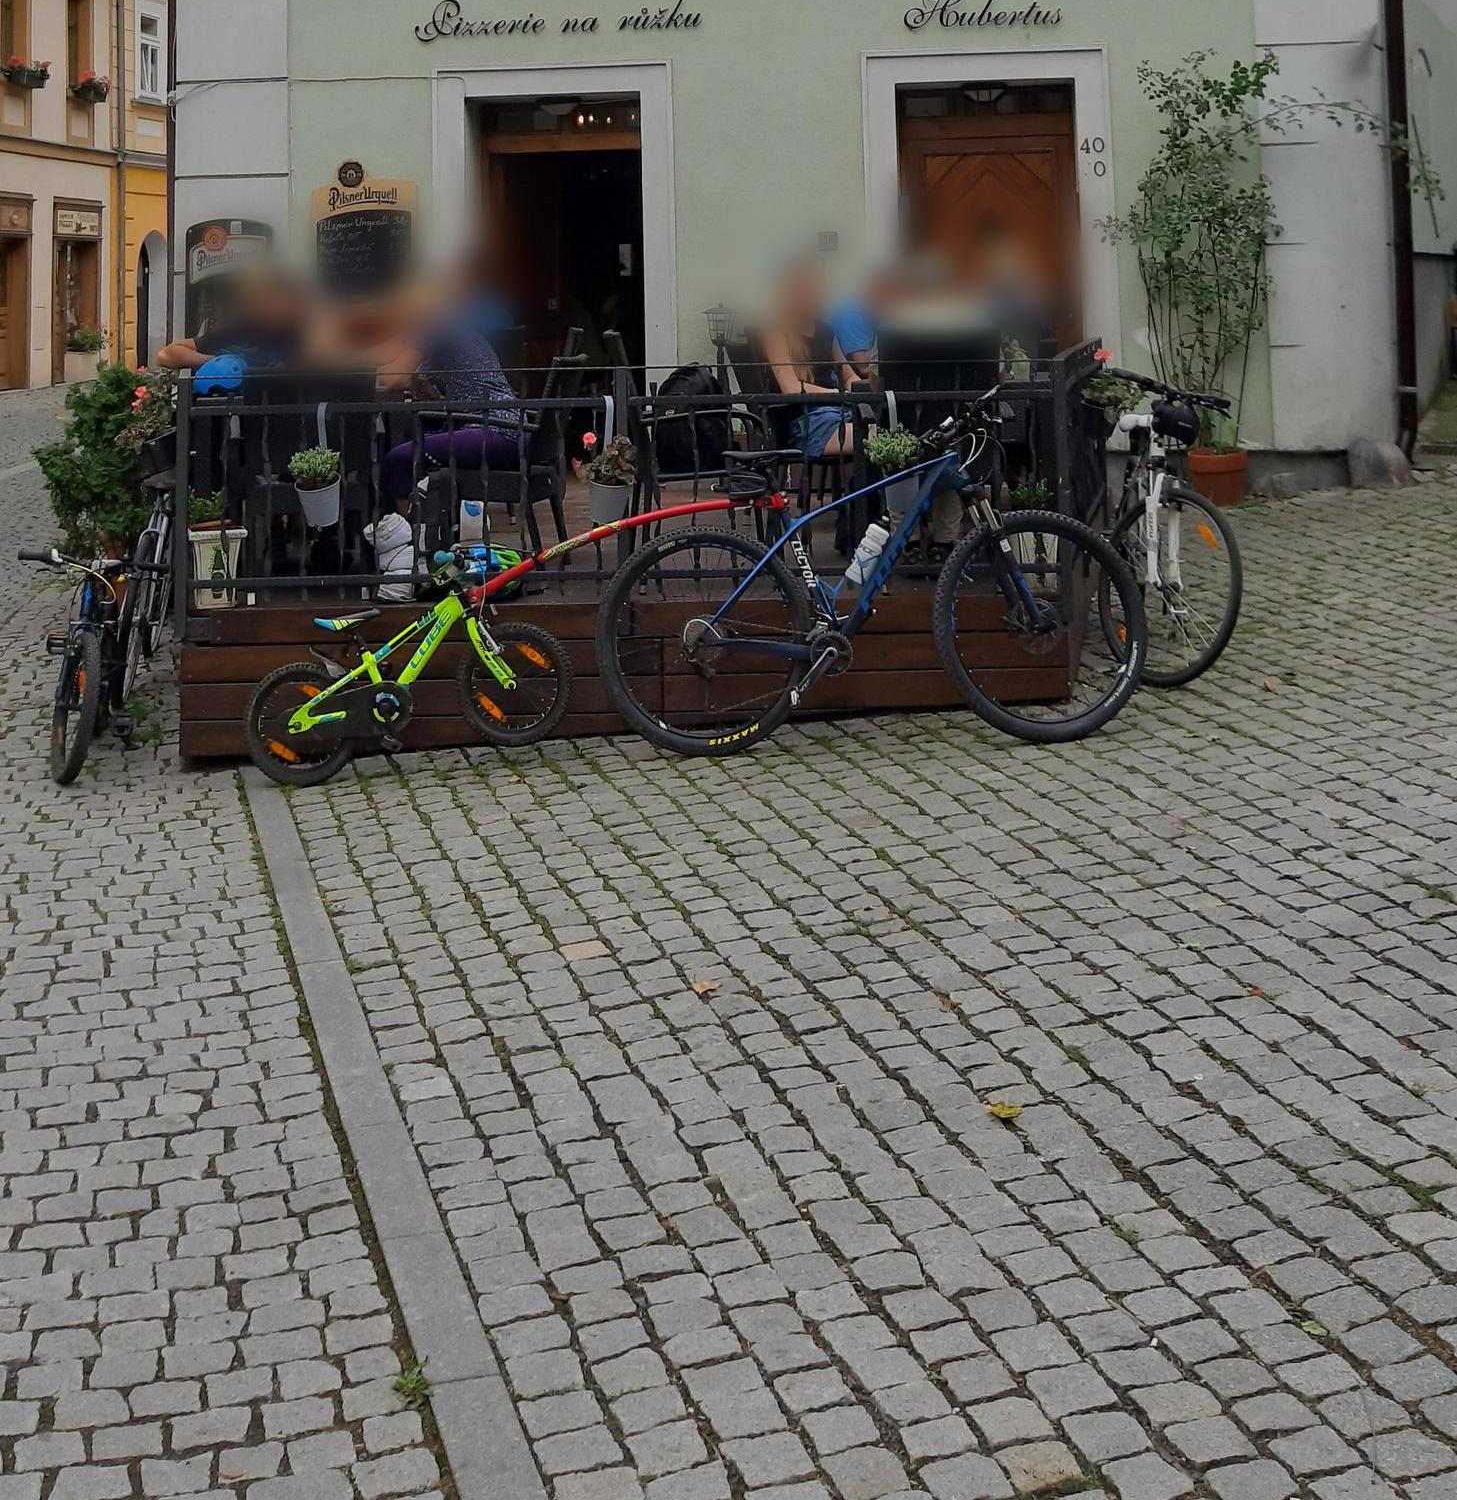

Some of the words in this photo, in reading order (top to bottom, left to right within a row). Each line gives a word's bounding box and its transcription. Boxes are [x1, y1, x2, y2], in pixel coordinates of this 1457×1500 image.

[415, 0, 546, 42] Pizzerie
[560, 14, 600, 33] na
[1080, 137, 1105, 153] 40
[328, 186, 365, 212] Pilsner
[363, 185, 398, 205] Urquell
[410, 607, 452, 670] CUBE
[709, 723, 759, 745] MAXXIS
